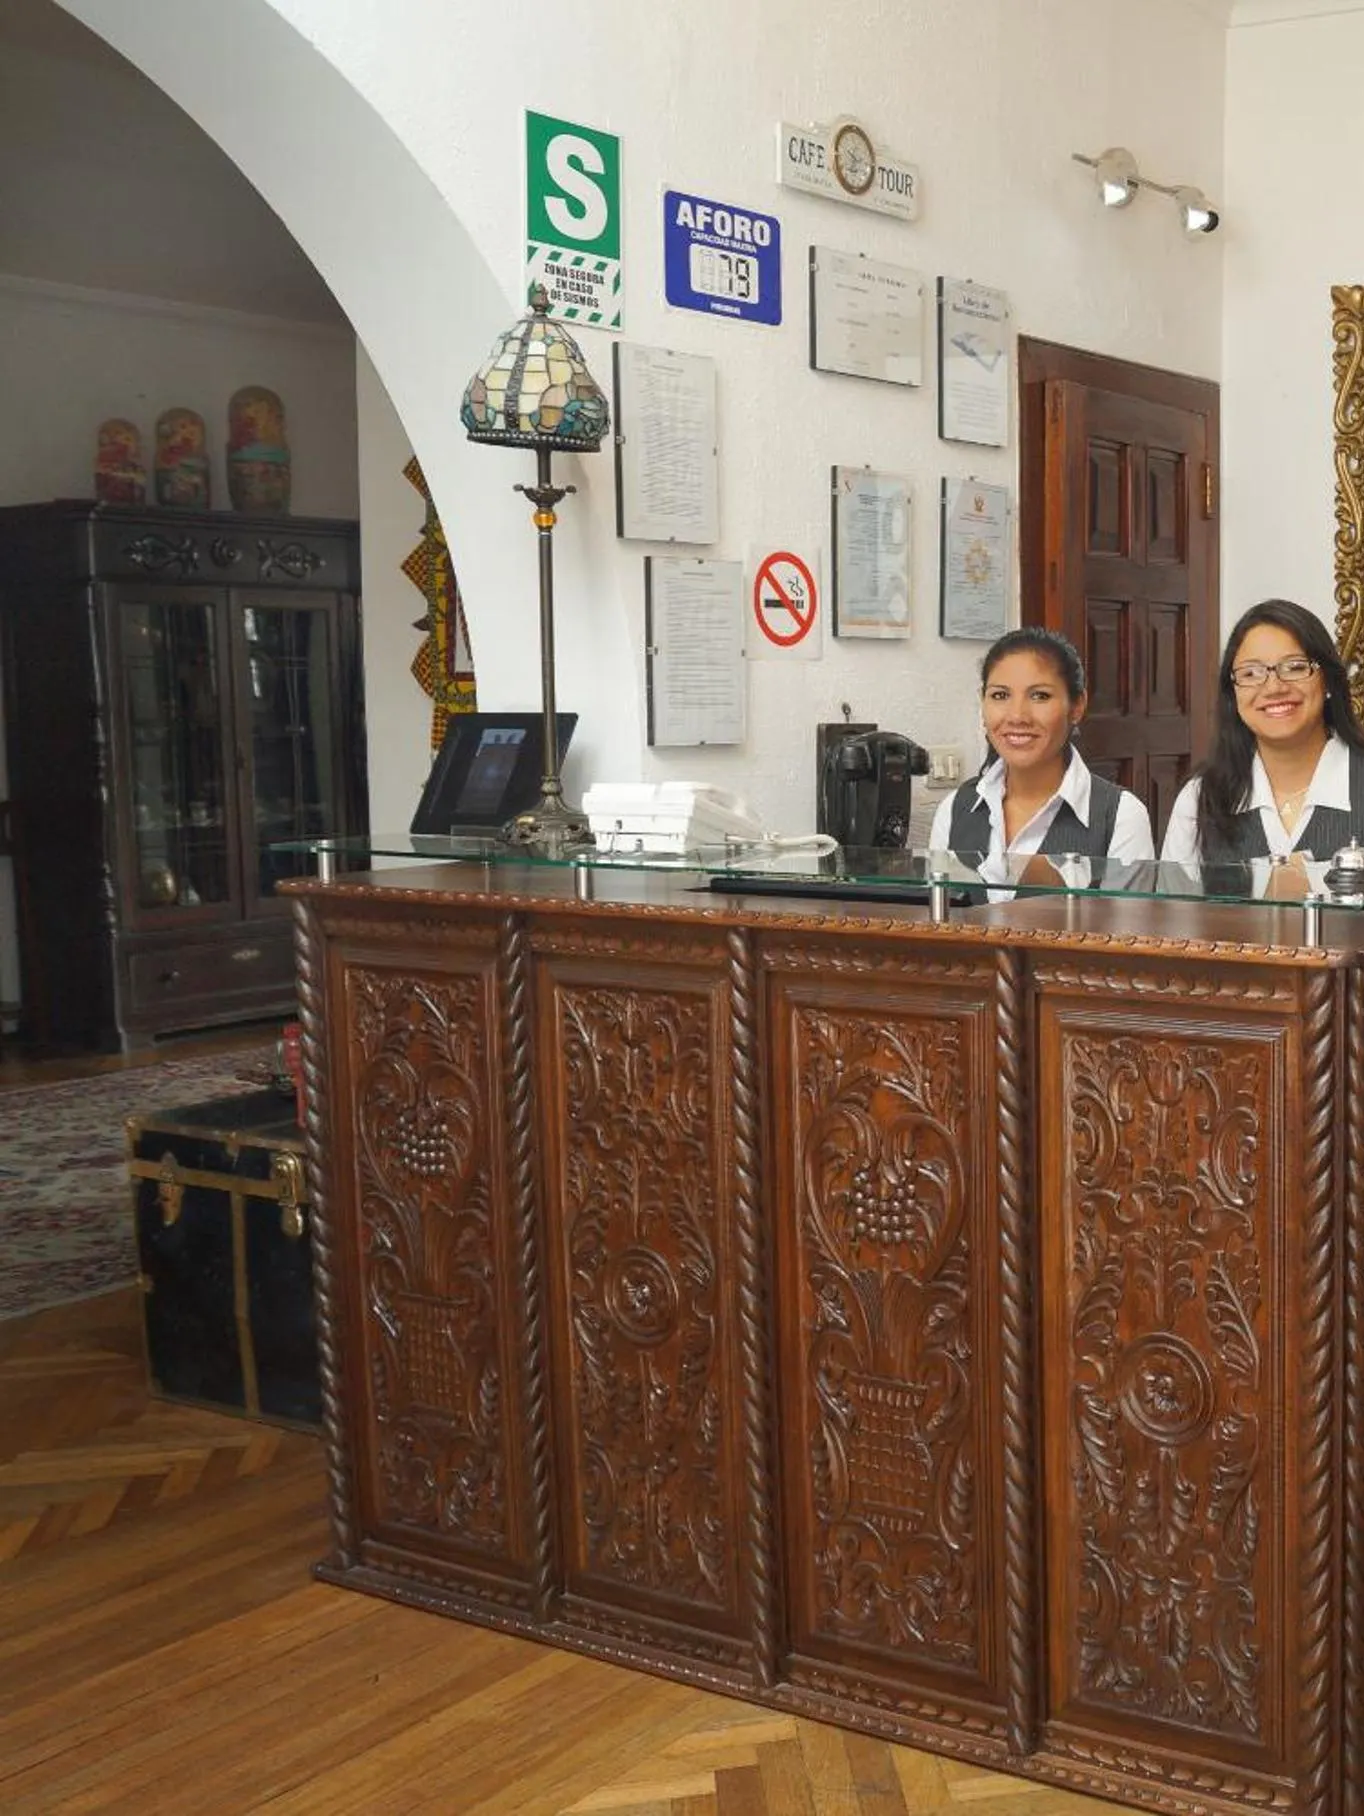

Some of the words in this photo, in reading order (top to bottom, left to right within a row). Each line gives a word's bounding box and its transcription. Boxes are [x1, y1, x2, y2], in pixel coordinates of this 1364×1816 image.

[543, 134, 608, 240] S
[788, 136, 825, 169] CAFE
[878, 166, 914, 199] TOUR
[676, 200, 771, 246] AFORO
[544, 263, 568, 278] ZONA
[569, 269, 605, 285] SEGURA
[556, 278, 567, 290] EN
[569, 281, 593, 295] CASO
[719, 254, 750, 299] 79
[550, 288, 562, 301] DE
[563, 292, 599, 308] SISMOS
